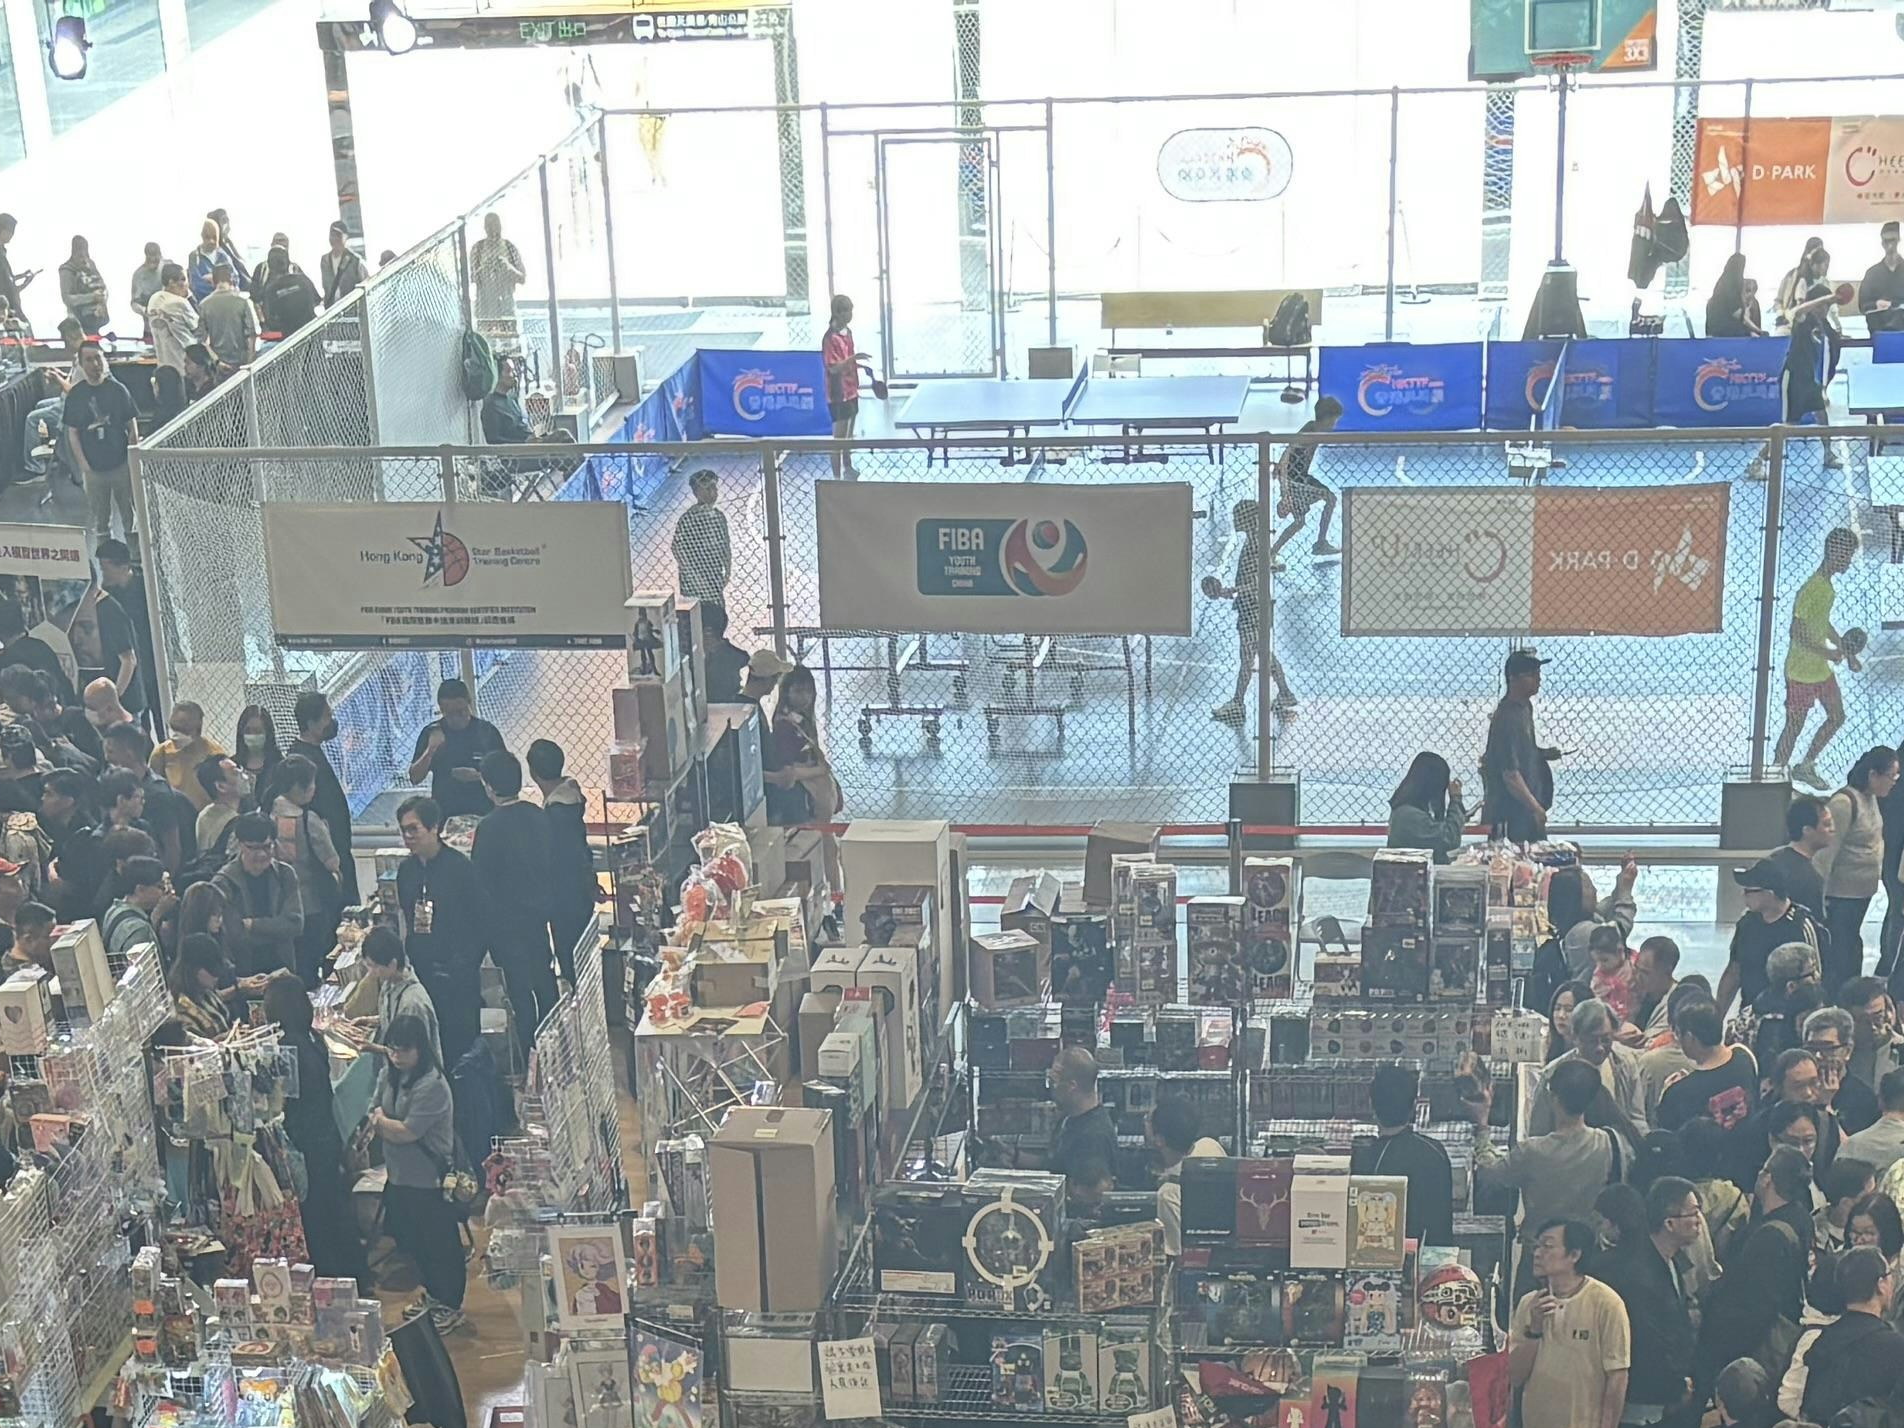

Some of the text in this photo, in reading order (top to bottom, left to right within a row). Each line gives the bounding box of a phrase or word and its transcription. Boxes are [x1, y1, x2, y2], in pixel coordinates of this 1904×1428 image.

[938, 527, 985, 551] FIBA
[360, 551, 424, 565] Hong Kong
[472, 557, 541, 568] Training Centre
[948, 556, 977, 566] YOUTH
